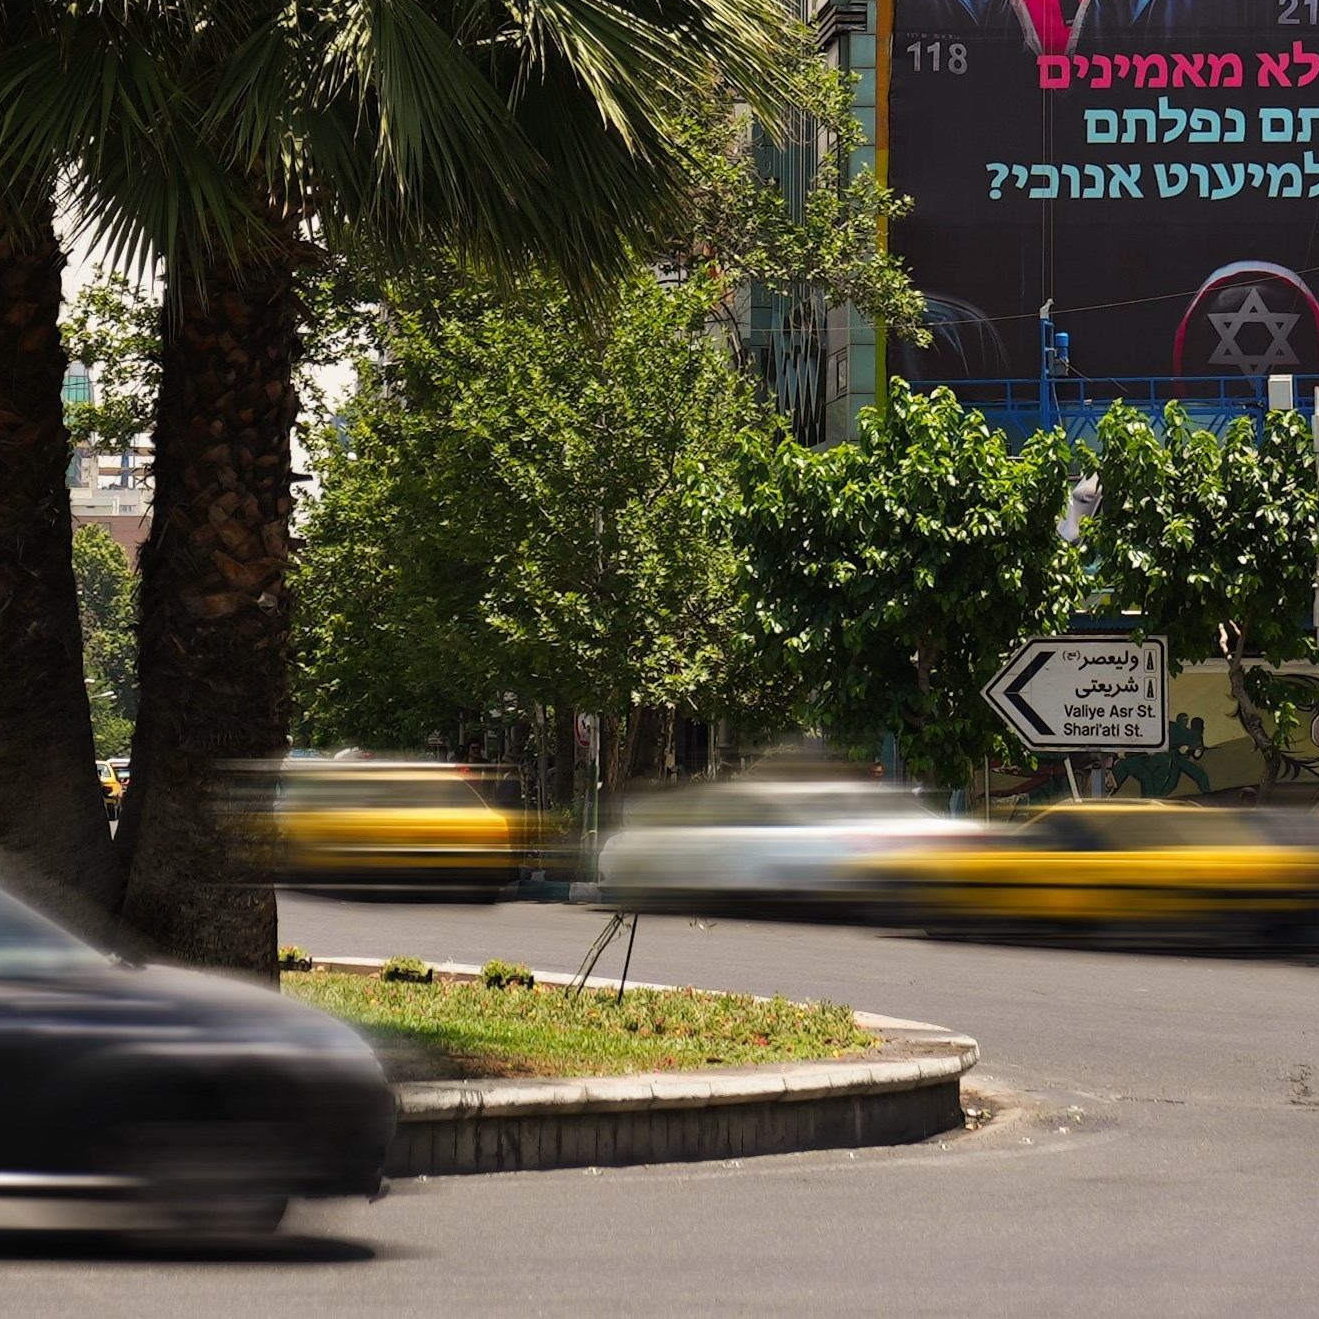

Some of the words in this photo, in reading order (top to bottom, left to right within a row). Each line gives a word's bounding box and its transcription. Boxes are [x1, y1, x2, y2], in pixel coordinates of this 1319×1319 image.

[906, 41, 969, 75] 118
[1037, 53, 1243, 89] מאמינים
[1083, 97, 1246, 143] נפלתם
[986, 162, 1144, 200] אנוכי?
[1075, 676, 1139, 698] شریعتی
[1064, 704, 1105, 720] Valiye
[1110, 704, 1134, 718] Asr
[1137, 704, 1156, 718] St.
[1064, 722, 1120, 737] Shari'ati
[1124, 723, 1144, 738] St.
